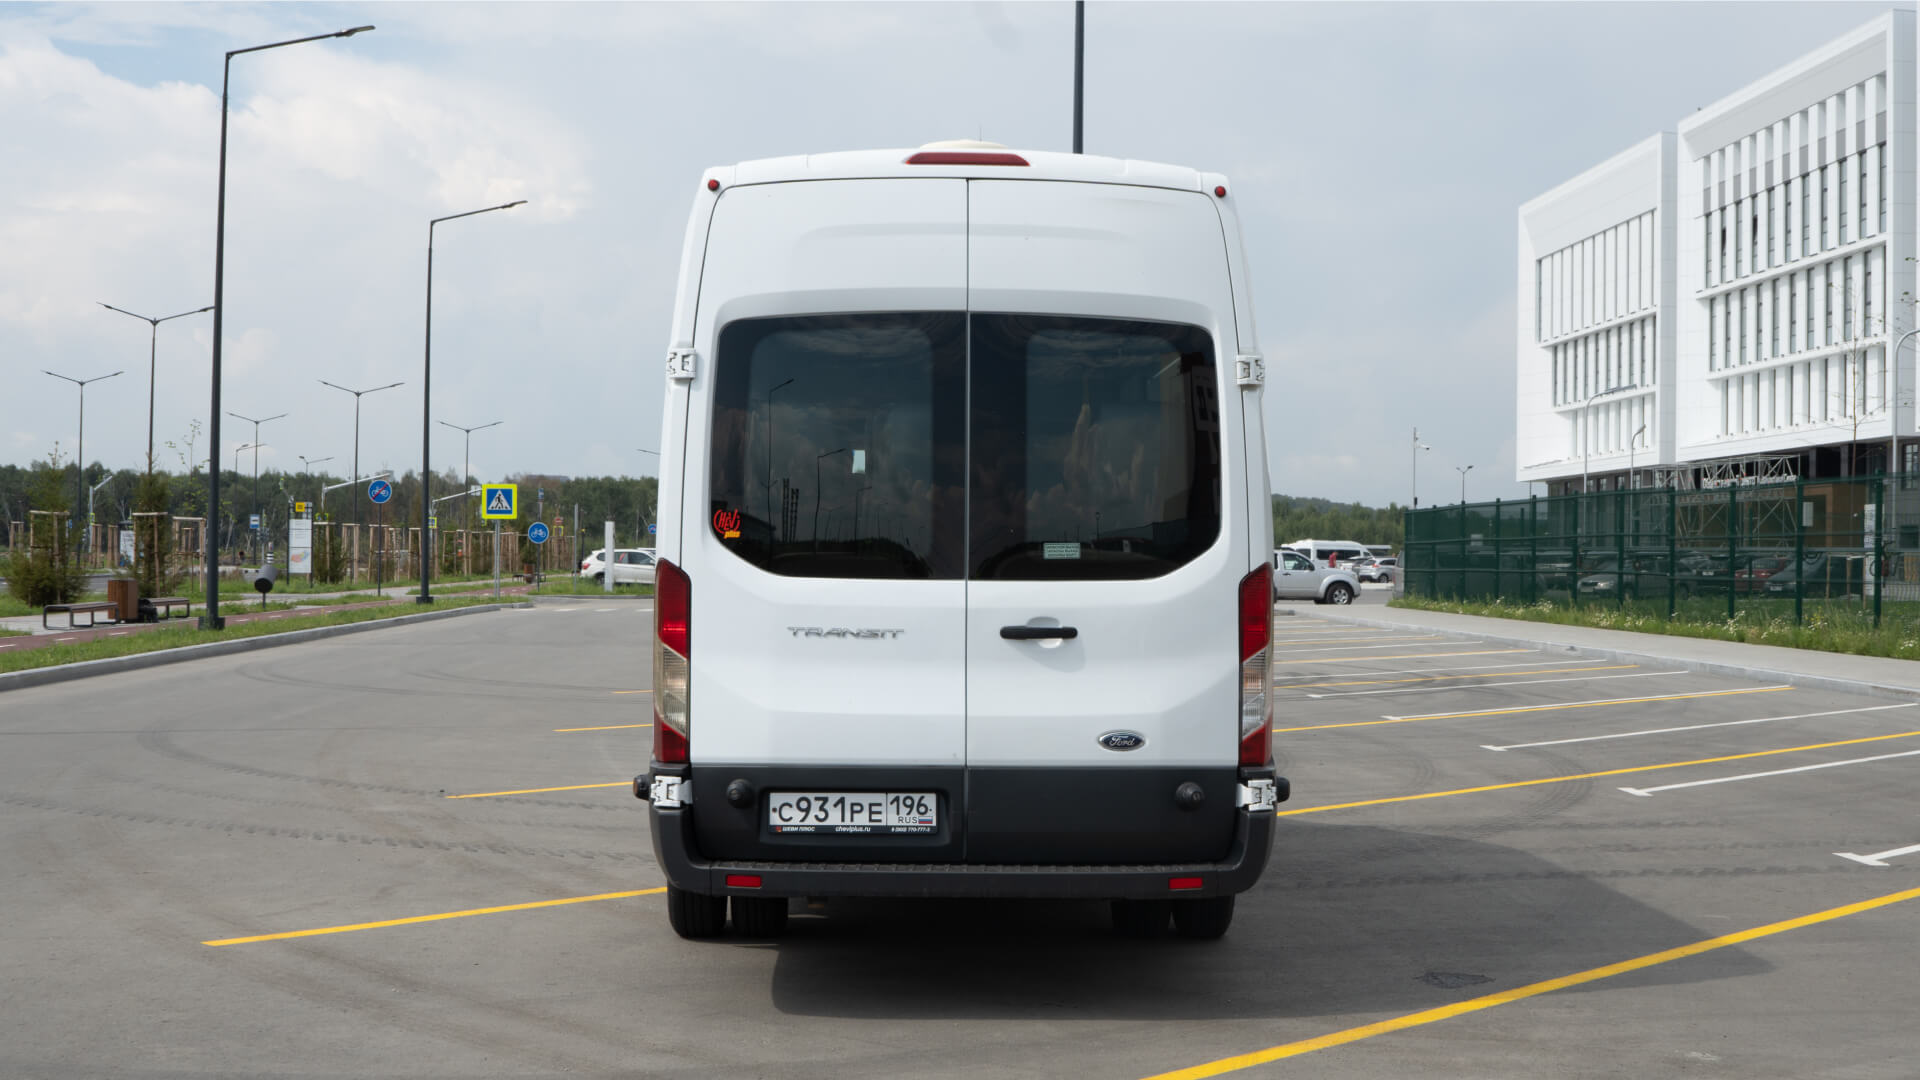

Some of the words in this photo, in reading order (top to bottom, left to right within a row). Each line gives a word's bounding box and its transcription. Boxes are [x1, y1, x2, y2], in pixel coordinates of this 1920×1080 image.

[787, 626, 905, 639] TRANSIT
[1109, 735, 1136, 747] Ford
[890, 795, 929, 816] 196
[898, 816, 918, 824] RUS
[835, 825, 871, 833] cheviplus.ru
